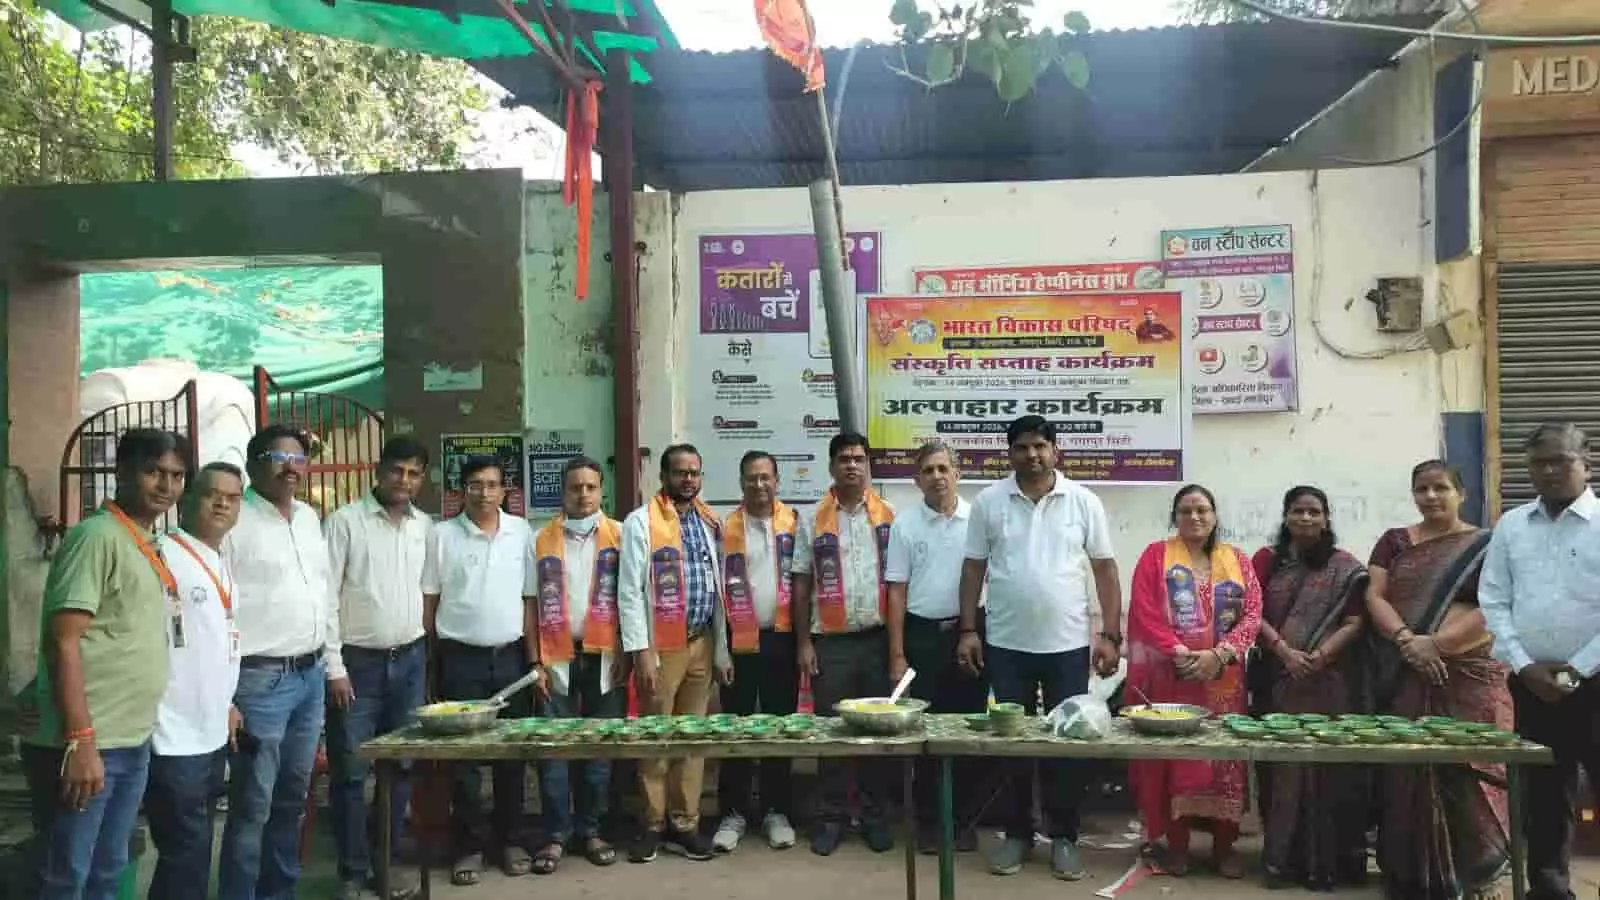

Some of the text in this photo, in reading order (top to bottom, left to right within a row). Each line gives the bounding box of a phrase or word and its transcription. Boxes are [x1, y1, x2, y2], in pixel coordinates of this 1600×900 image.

[716, 261, 785, 289] कतारों
[760, 289, 800, 319] बचें
[943, 319, 992, 334] भारत
[996, 316, 1063, 334] विकास
[888, 351, 1155, 375] संस्कृति सप्ताह कार्यक्रम
[883, 392, 1165, 417] अल्पाहार कार्यक्रम
